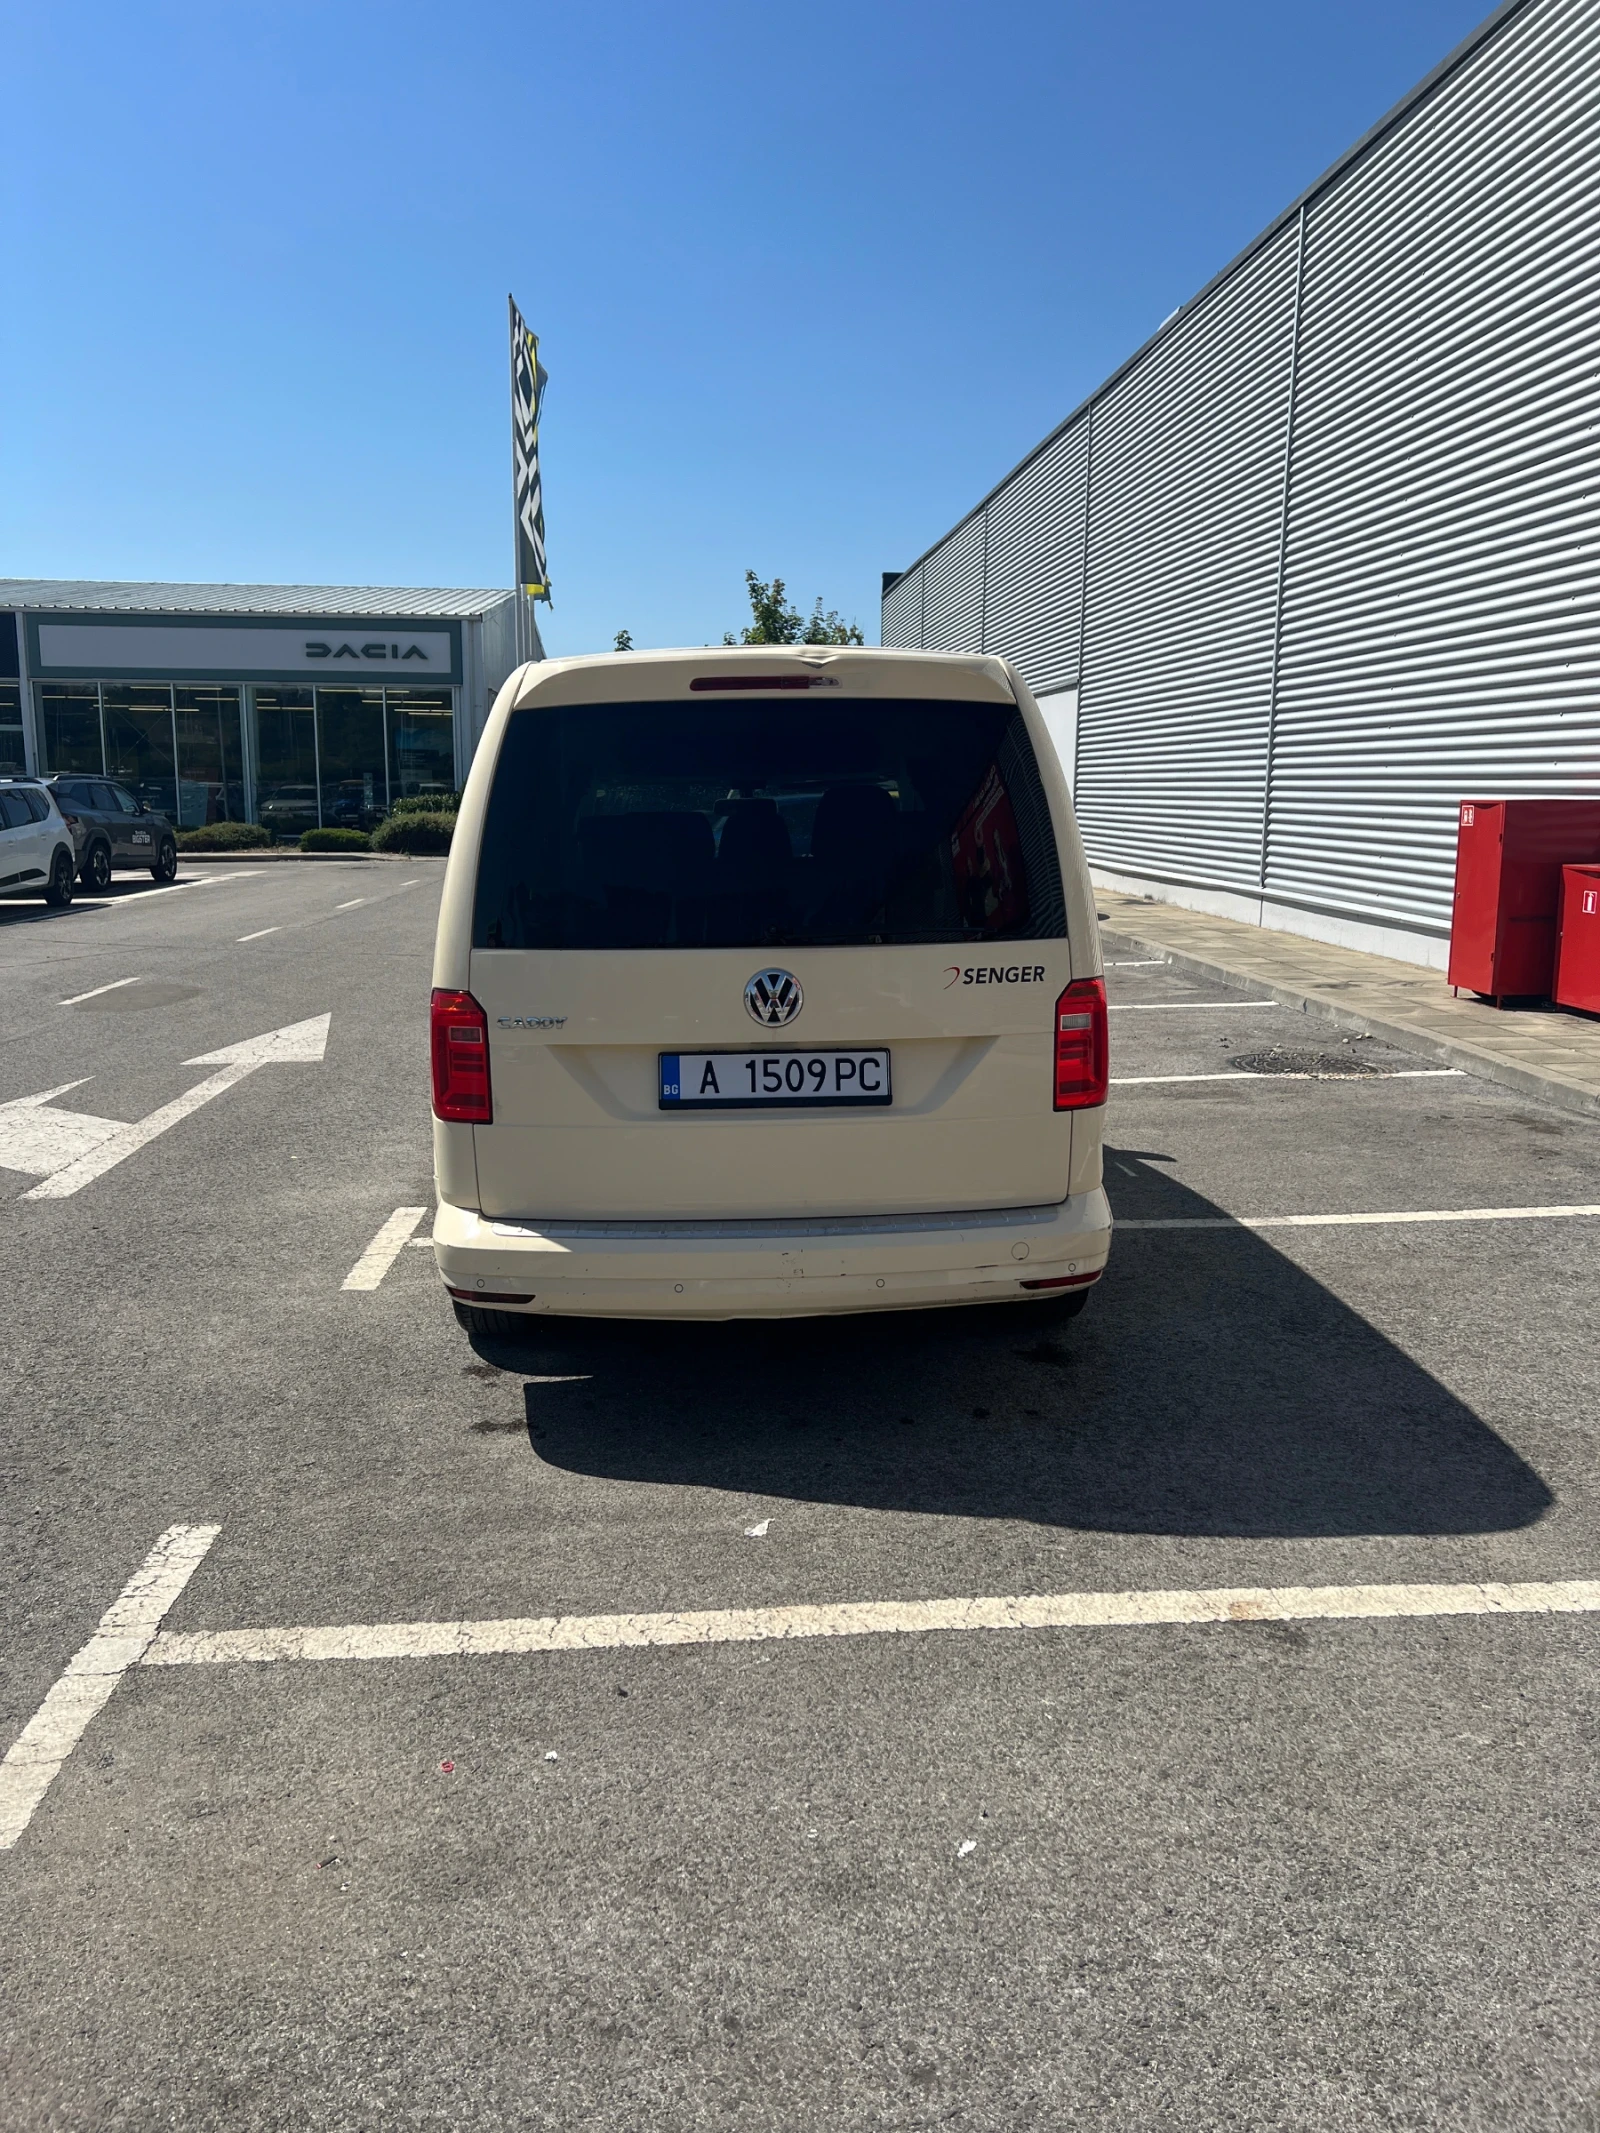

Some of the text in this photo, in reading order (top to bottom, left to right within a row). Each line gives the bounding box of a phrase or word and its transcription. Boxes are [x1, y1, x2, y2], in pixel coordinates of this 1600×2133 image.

[305, 642, 429, 660] DACIA
[962, 965, 1046, 985] SENGER
[496, 1016, 568, 1030] CADDY
[699, 1060, 720, 1094] A
[663, 1084, 679, 1095] BG
